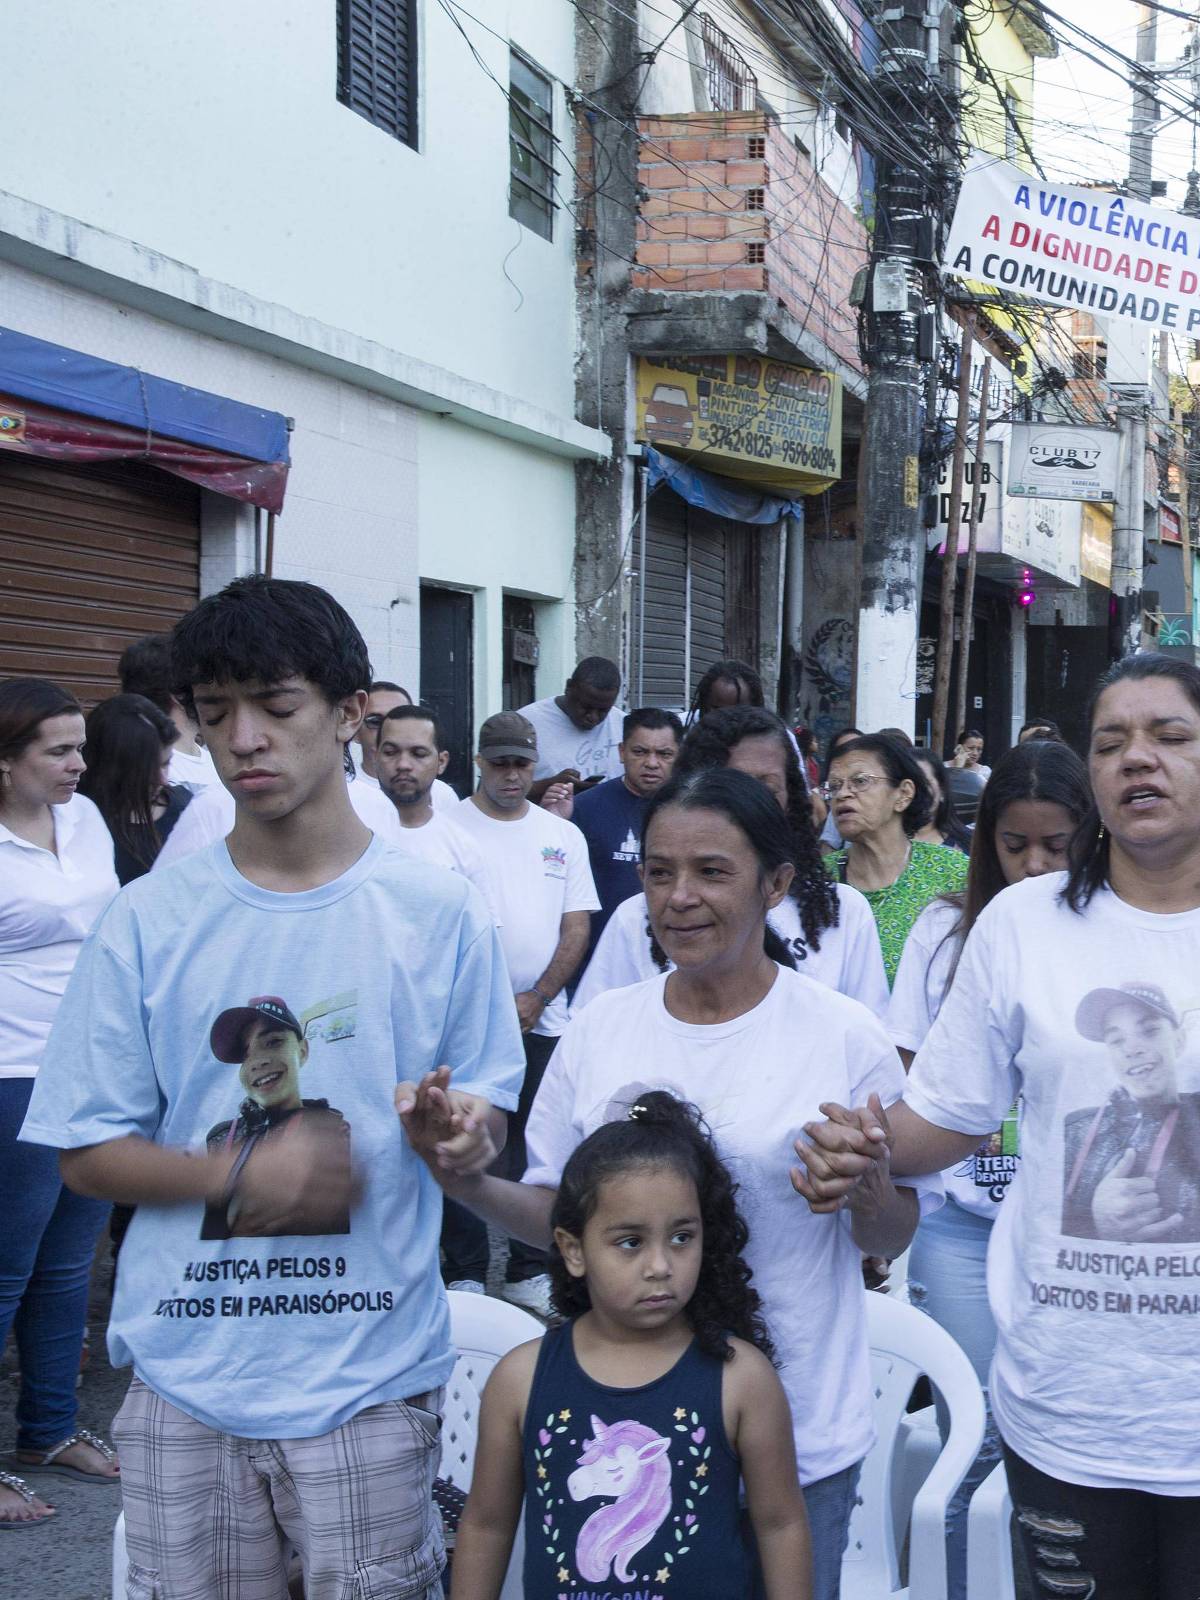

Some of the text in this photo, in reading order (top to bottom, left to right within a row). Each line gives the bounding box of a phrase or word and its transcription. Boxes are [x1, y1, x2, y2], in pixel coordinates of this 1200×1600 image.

[1014, 185, 1031, 210] A
[1039, 193, 1189, 255] VIOLÊNCIA
[981, 214, 1001, 241] A
[1010, 222, 1173, 288] DIGNIDADE
[953, 245, 972, 272] A
[982, 253, 1180, 327] COMUNIDADE
[1029, 446, 1102, 460] CLUB 17
[937, 462, 991, 485] CUB
[266, 1257, 331, 1280] PELOS
[335, 1256, 347, 1278] 9
[249, 1290, 394, 1317] PARAISÓPOLIS
[1104, 1291, 1132, 1313] EM
